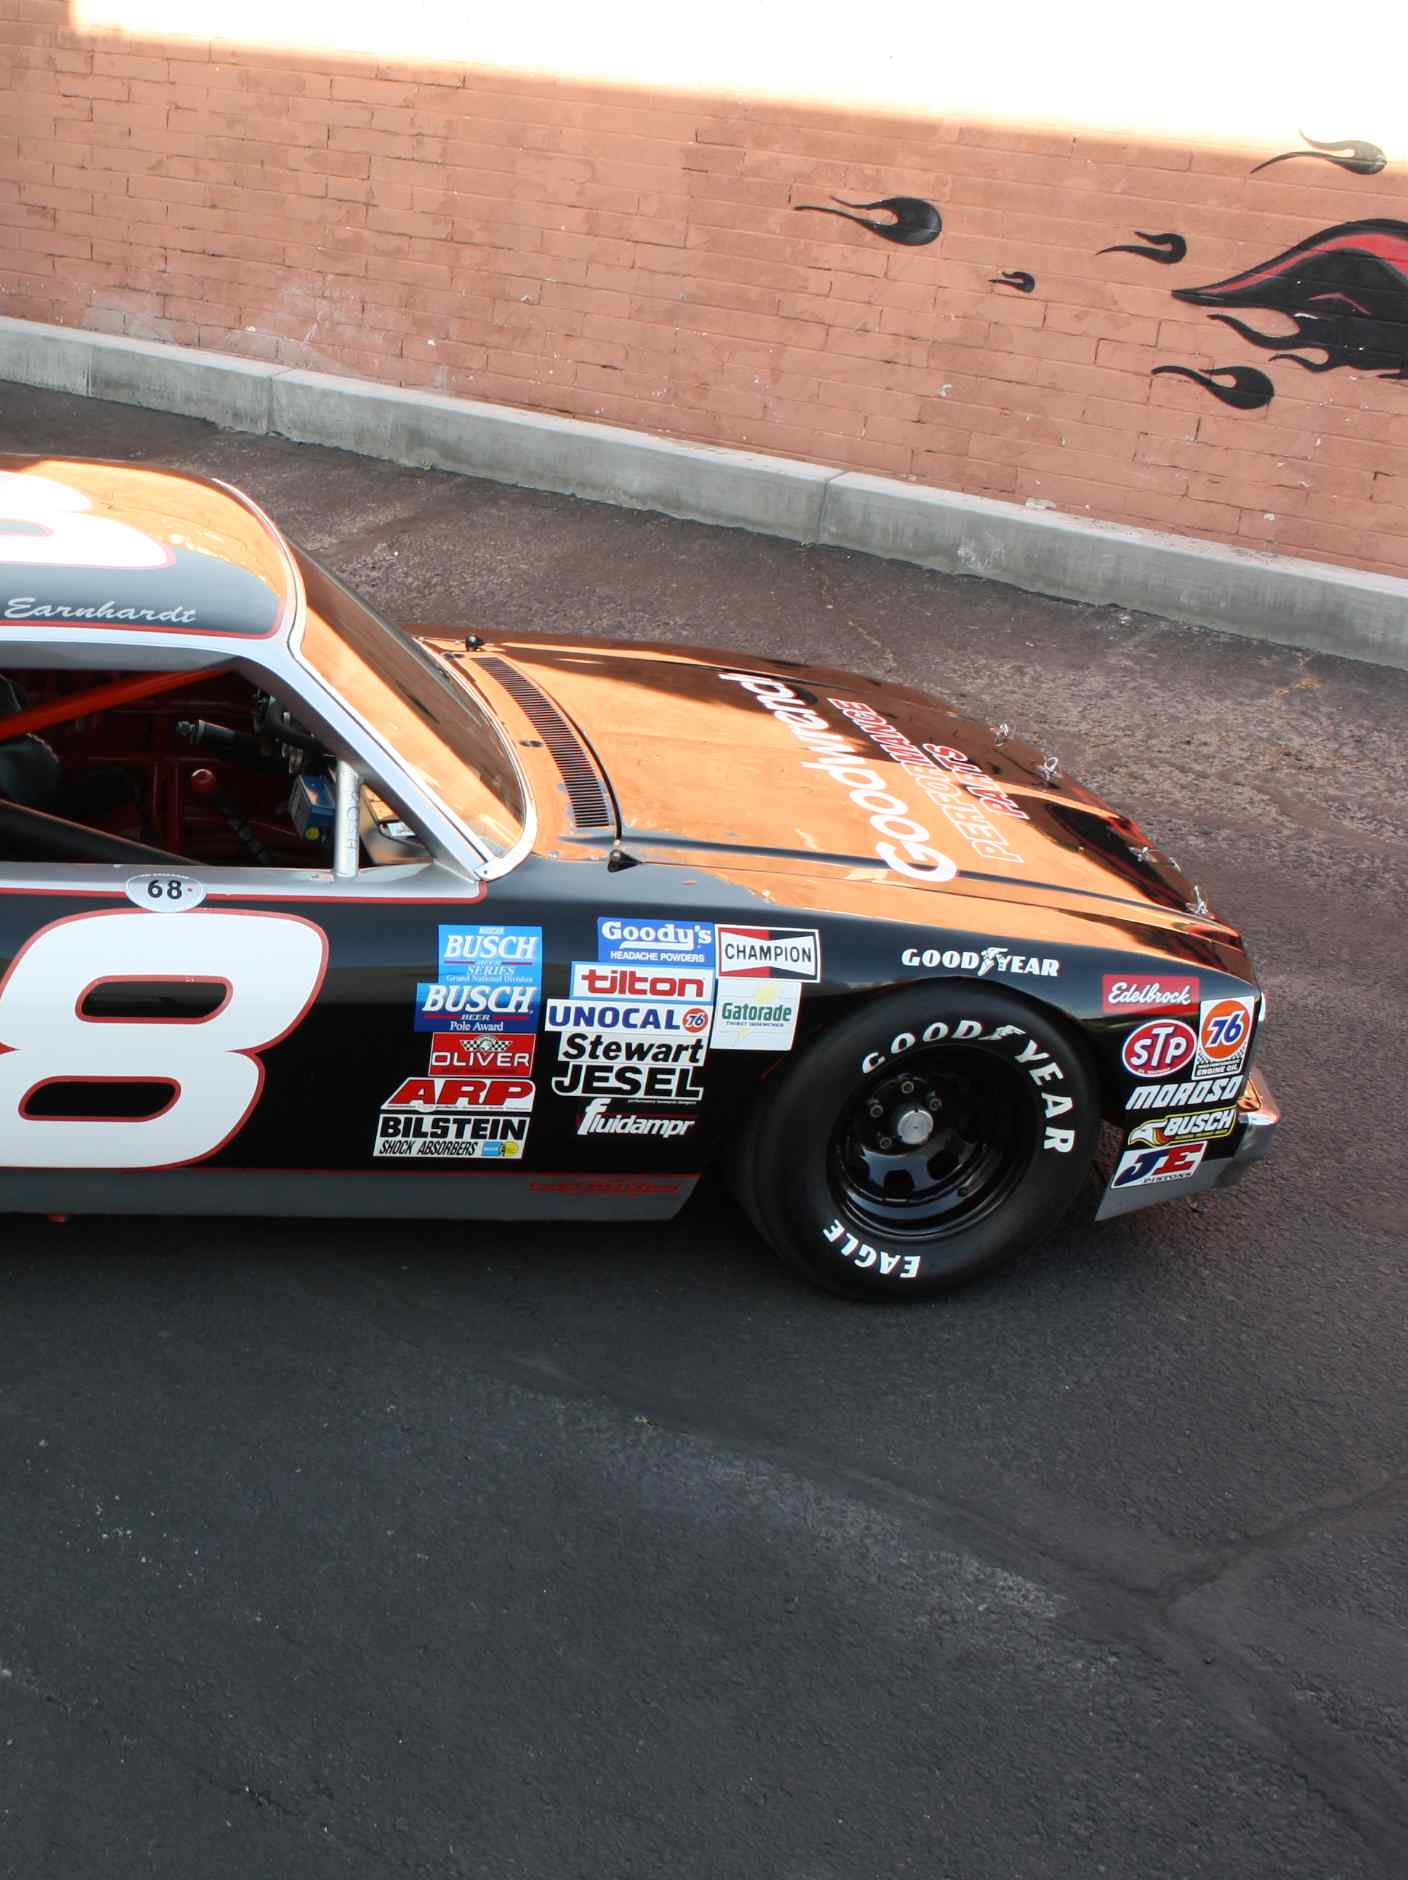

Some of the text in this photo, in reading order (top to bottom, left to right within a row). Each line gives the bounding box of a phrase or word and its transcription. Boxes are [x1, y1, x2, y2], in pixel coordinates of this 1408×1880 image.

[3, 596, 197, 623] Earnhardt
[827, 698, 1025, 863] PERFORMANCE
[922, 742, 1031, 820] PARTS
[147, 880, 182, 900] 68
[444, 935, 538, 960] BUSCH
[601, 921, 713, 951] Goody's
[610, 951, 705, 963] HEADACHE POWDERS
[724, 943, 812, 963] CHAMPION
[901, 946, 1061, 977] GOODYEAR
[466, 964, 515, 976] SERIES
[581, 969, 705, 998] tilton
[421, 984, 537, 1013] BUSCH
[1107, 982, 1192, 1005] Edelbrock
[548, 1005, 704, 1031] UNOCAL 76
[721, 1002, 792, 1022] Gatorade
[450, 1021, 504, 1032] Pole Award
[1204, 1010, 1245, 1048] 76
[431, 1051, 530, 1068] OLIVER
[562, 1033, 704, 1064] Stewart
[1130, 1026, 1187, 1067] STP
[553, 1063, 702, 1099] JESEL
[1196, 1065, 1225, 1077] ENGINE
[1225, 1064, 1239, 1073] OIL
[388, 1079, 534, 1106] ARP
[1125, 1075, 1243, 1111] MOROSO
[379, 1116, 527, 1140] BILSTEIN
[577, 1098, 696, 1138] fluidampr
[1163, 1109, 1237, 1137] BUSCH
[379, 1140, 479, 1156] SHOCK ABSORBERS
[1113, 1142, 1206, 1187] JE
[822, 1218, 922, 1280] EAGLE
